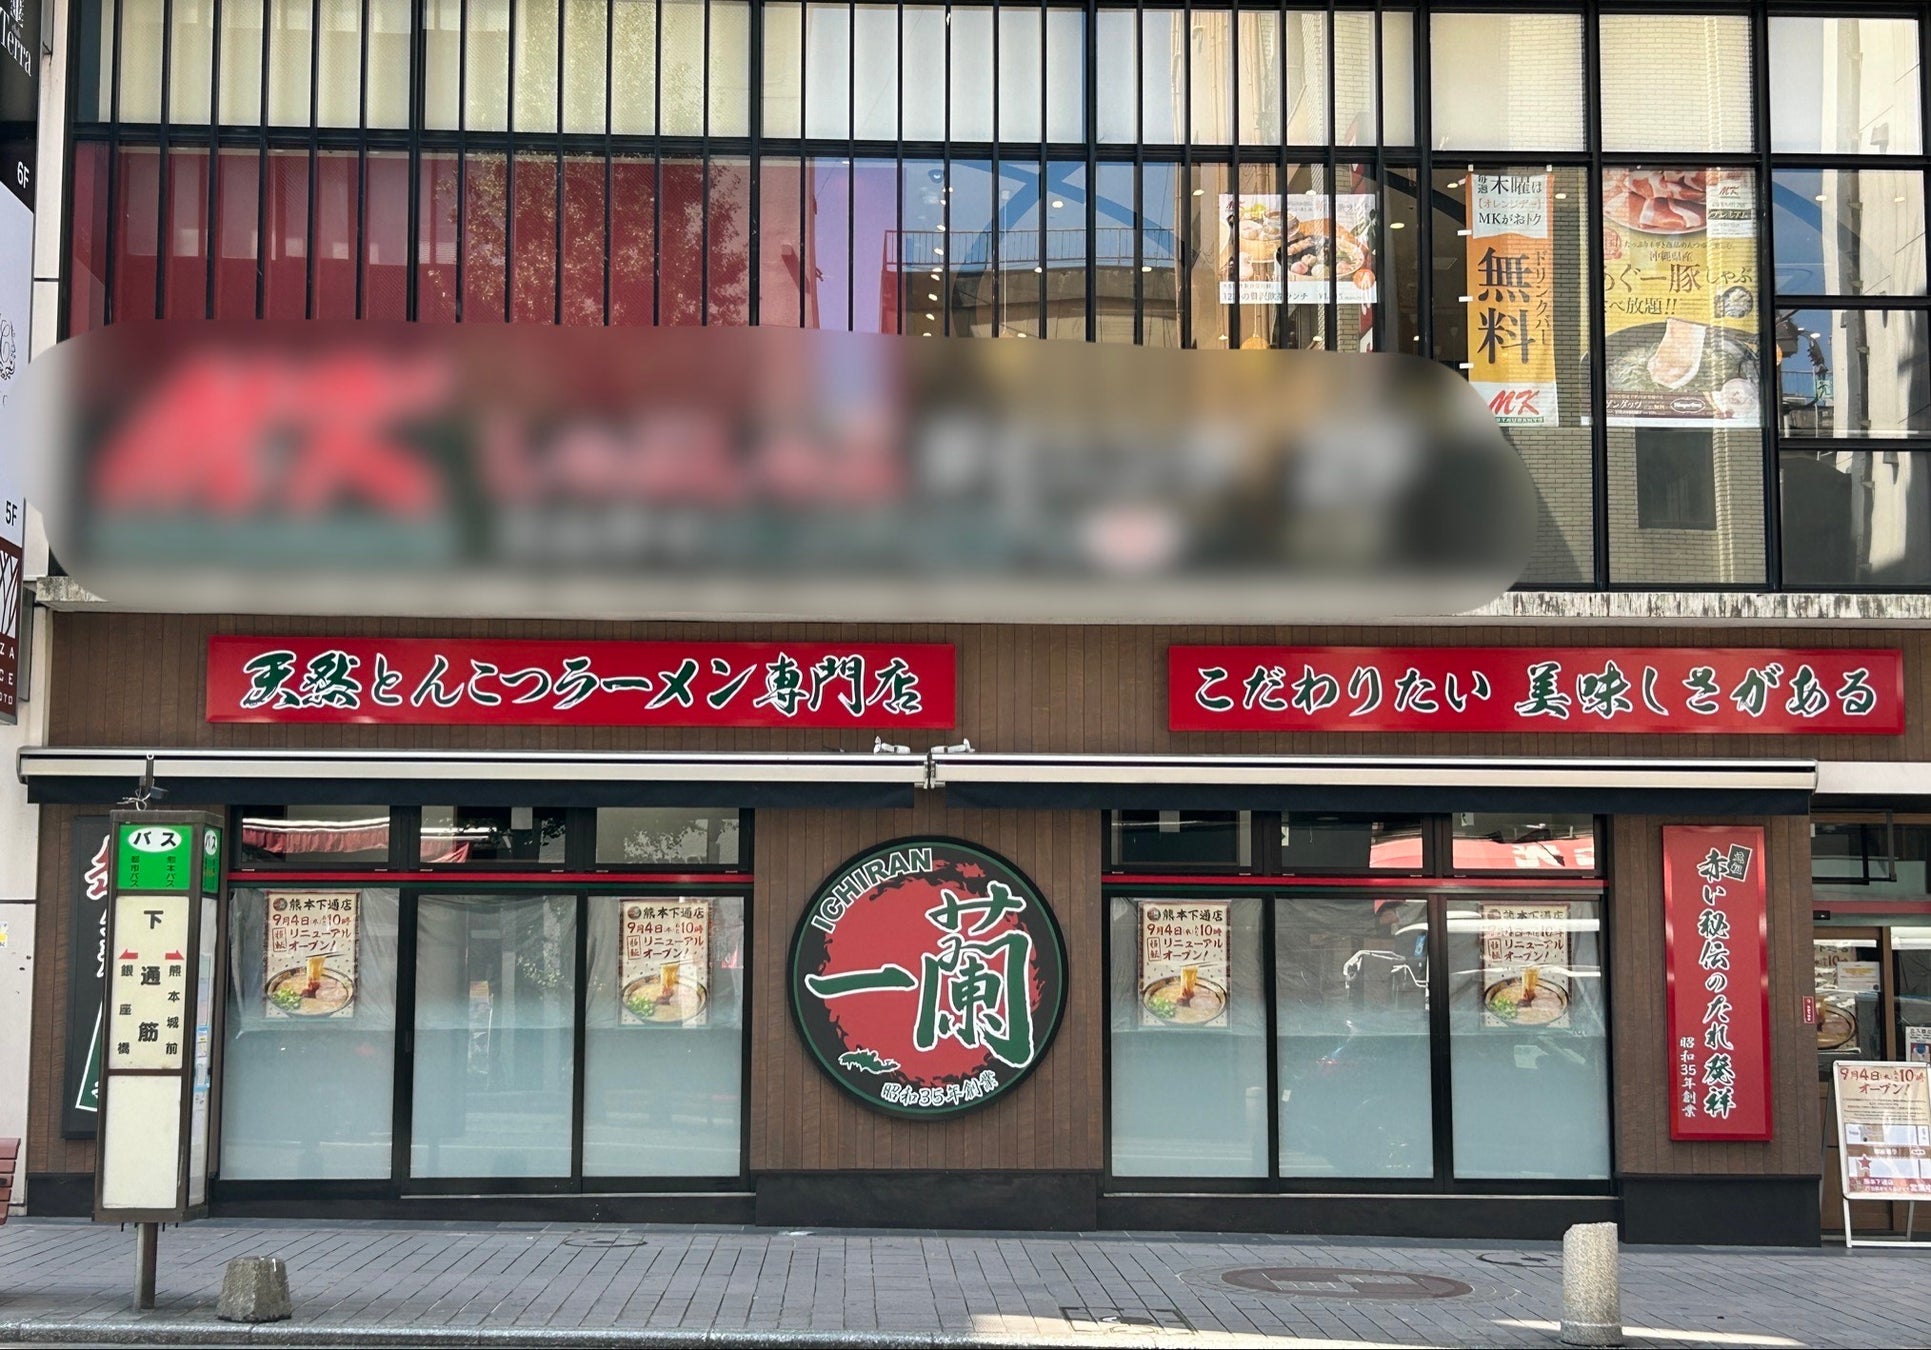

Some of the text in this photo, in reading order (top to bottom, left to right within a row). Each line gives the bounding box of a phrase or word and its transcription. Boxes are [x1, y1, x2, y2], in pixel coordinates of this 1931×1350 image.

[0, 7, 32, 77] Terra
[17, 161, 30, 189] 6F
[1479, 212, 1541, 226] MKがおトク
[1478, 247, 1533, 364] 無料
[1536, 250, 1549, 345] ドリンクバー
[1489, 390, 1540, 415] MK
[5, 500, 18, 526] 5F
[241, 649, 923, 717] 天然とんこつラーメン専門店
[1195, 660, 1878, 719] こだわりたい 美味しさがある
[133, 831, 177, 847] バス
[289, 898, 352, 911] 熊本下通店
[811, 848, 932, 934] ICHIRAN
[643, 907, 704, 919] 熊本下通店
[1162, 909, 1223, 921] 熊本下通店
[290, 928, 352, 939] リニューアル
[644, 936, 704, 947] リニューアル
[1164, 938, 1223, 948] リニューアル
[1505, 939, 1563, 949] リニューアル
[138, 910, 164, 1042] 下通筋
[804, 880, 1035, 1069] 一蘭
[117, 964, 133, 1055] 銀座橋
[165, 964, 181, 1055] 熊本城前
[881, 1071, 999, 1106] 昭和35年創業
[1680, 1036, 1697, 1118] 昭和35年創業
